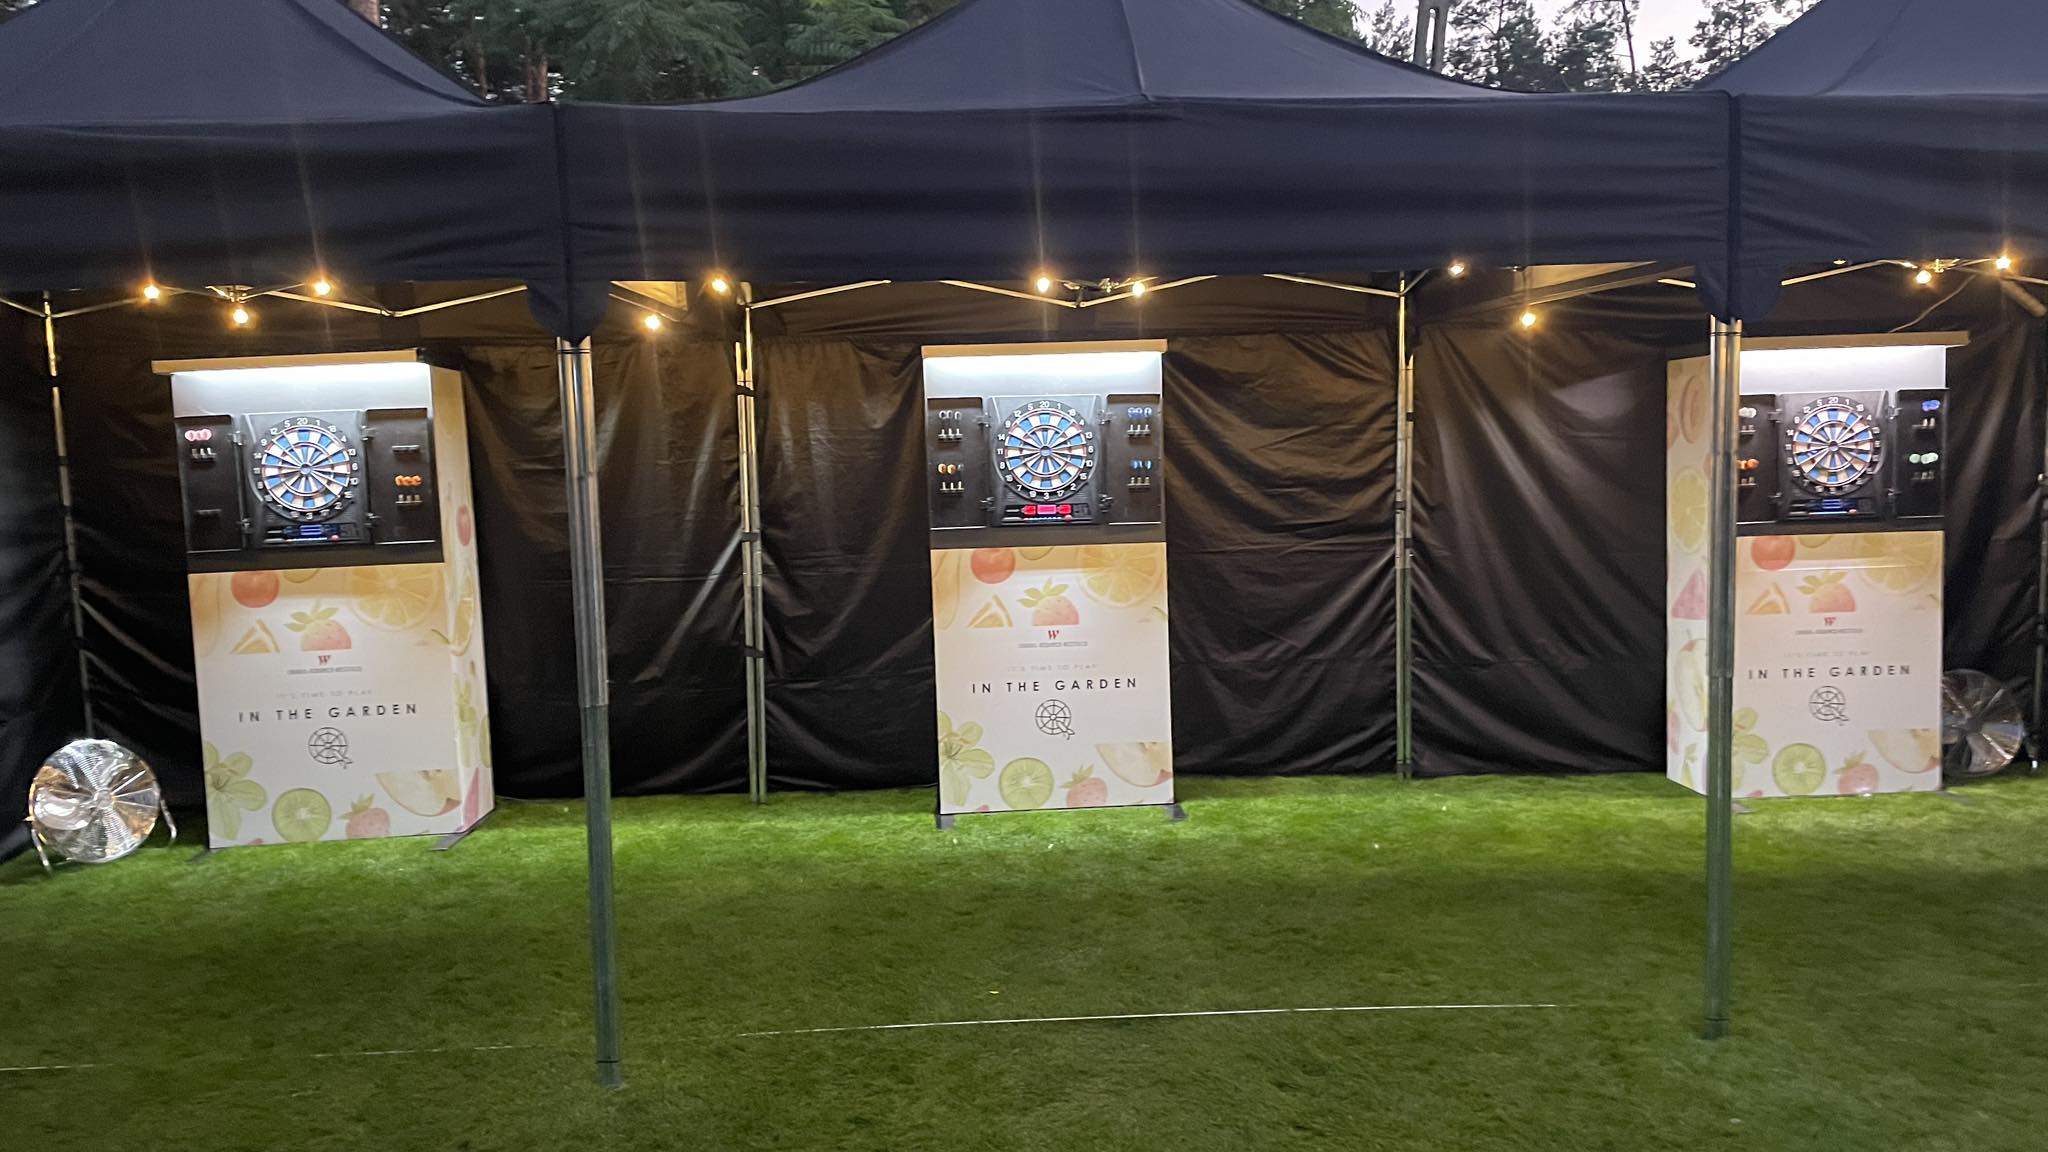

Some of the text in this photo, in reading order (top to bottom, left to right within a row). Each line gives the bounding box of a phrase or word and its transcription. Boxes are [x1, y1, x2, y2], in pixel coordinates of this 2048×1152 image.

[285, 420, 290, 428] 5
[1047, 630, 1060, 640] W
[318, 655, 332, 666] W
[1748, 665, 1911, 680] IN THE GARDEN
[972, 677, 1137, 694] IN THE GARDEN
[238, 704, 417, 723] IN THE GARDEN
